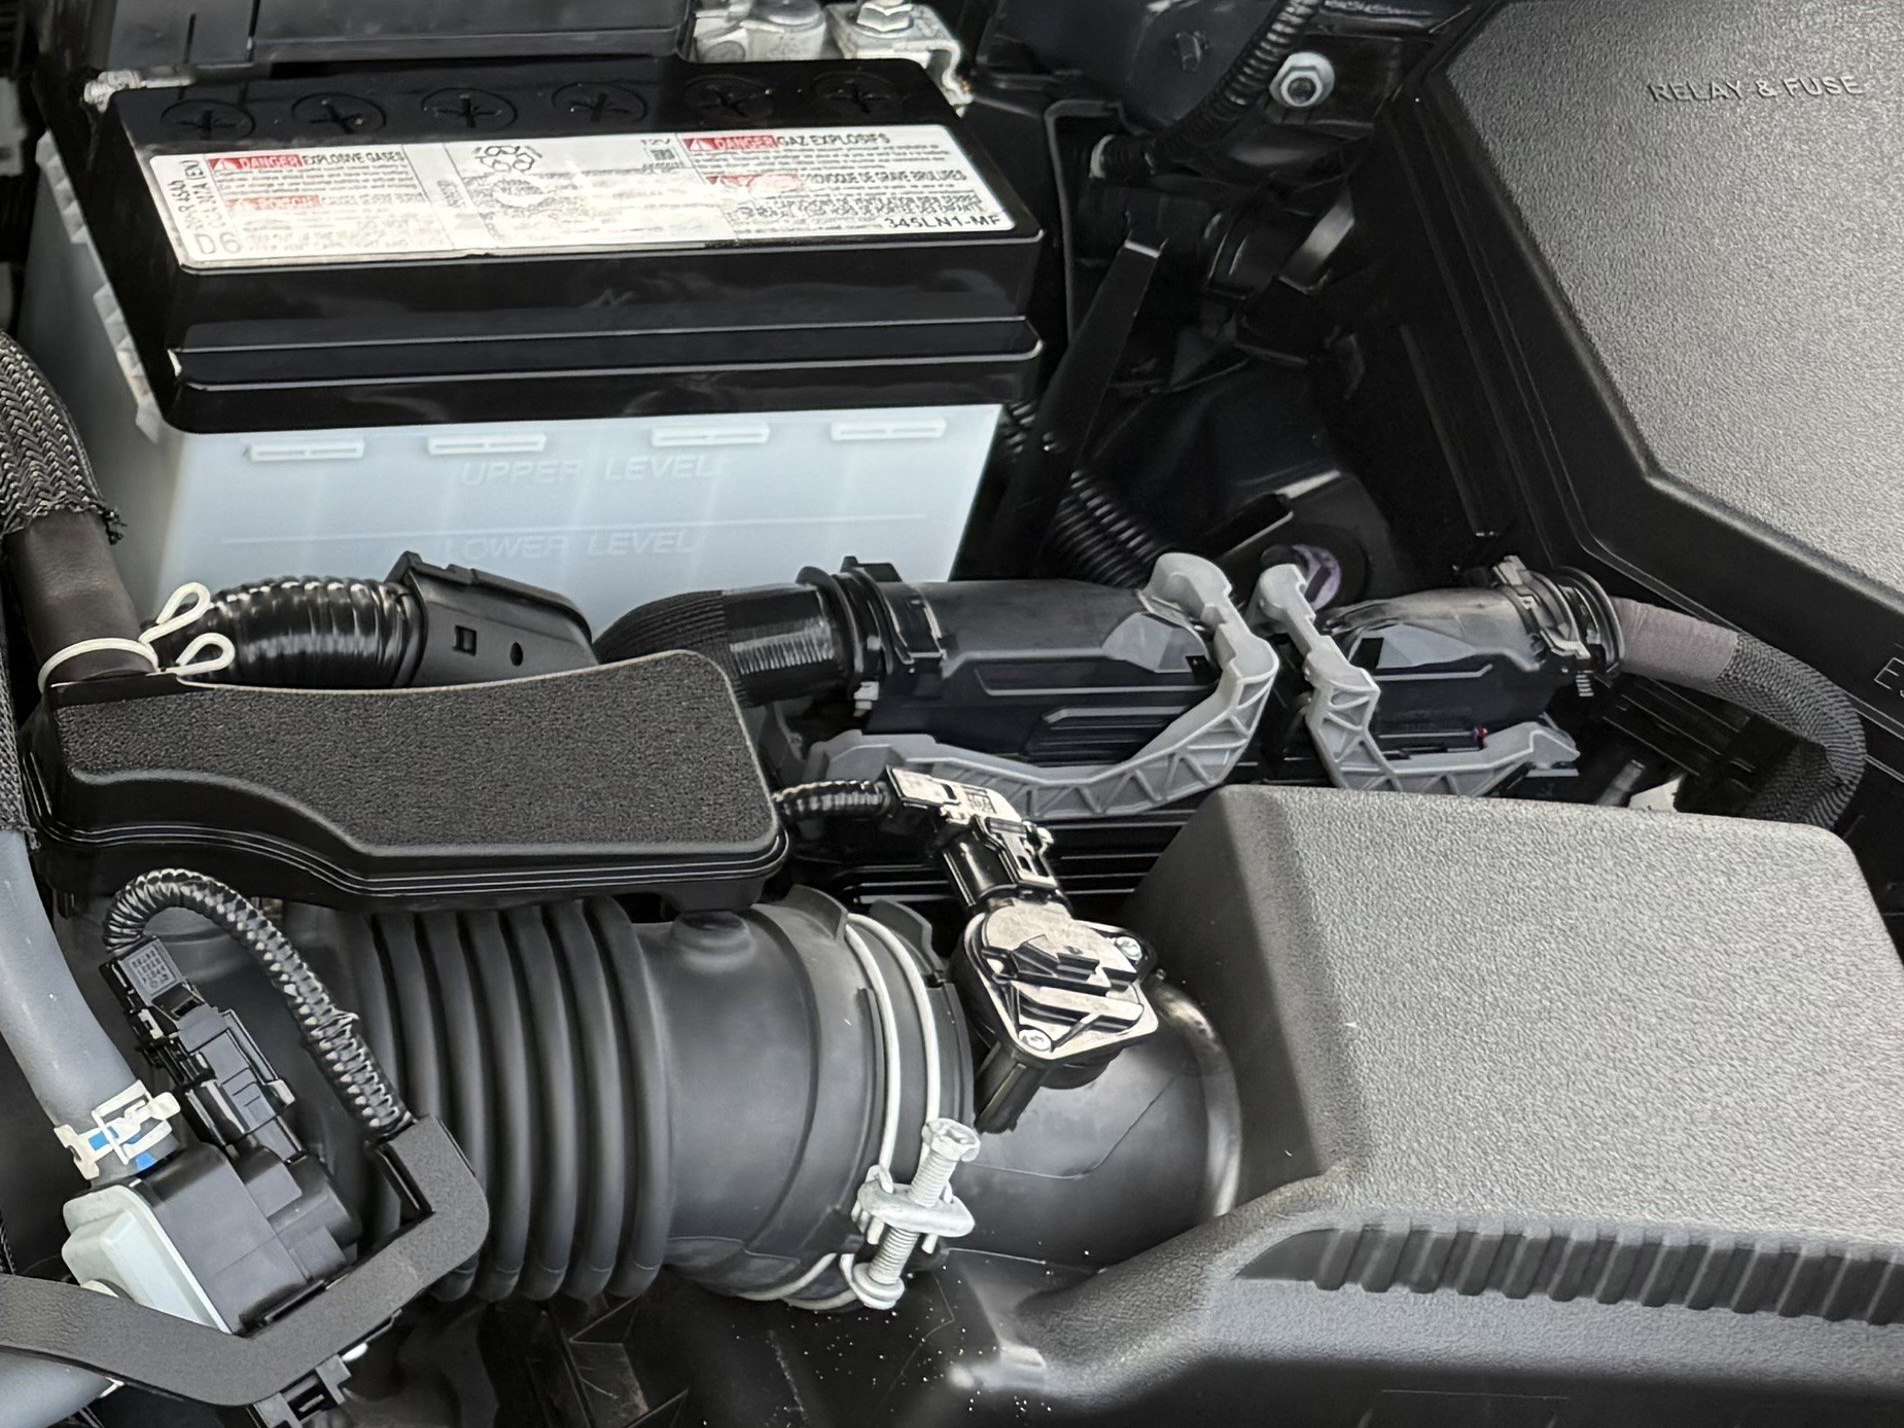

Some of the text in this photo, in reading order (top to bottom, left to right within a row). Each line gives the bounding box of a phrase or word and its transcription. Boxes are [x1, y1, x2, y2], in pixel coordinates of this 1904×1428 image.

[1647, 74, 1864, 103] RELAY & FUSE
[717, 132, 892, 149] DANGER GAZ EXPLOSIFS
[239, 151, 405, 170] DANGER EXPLOSIVE GASES
[460, 454, 718, 488] UPPER LEVEL
[445, 528, 702, 563] LOWER LEVEL
